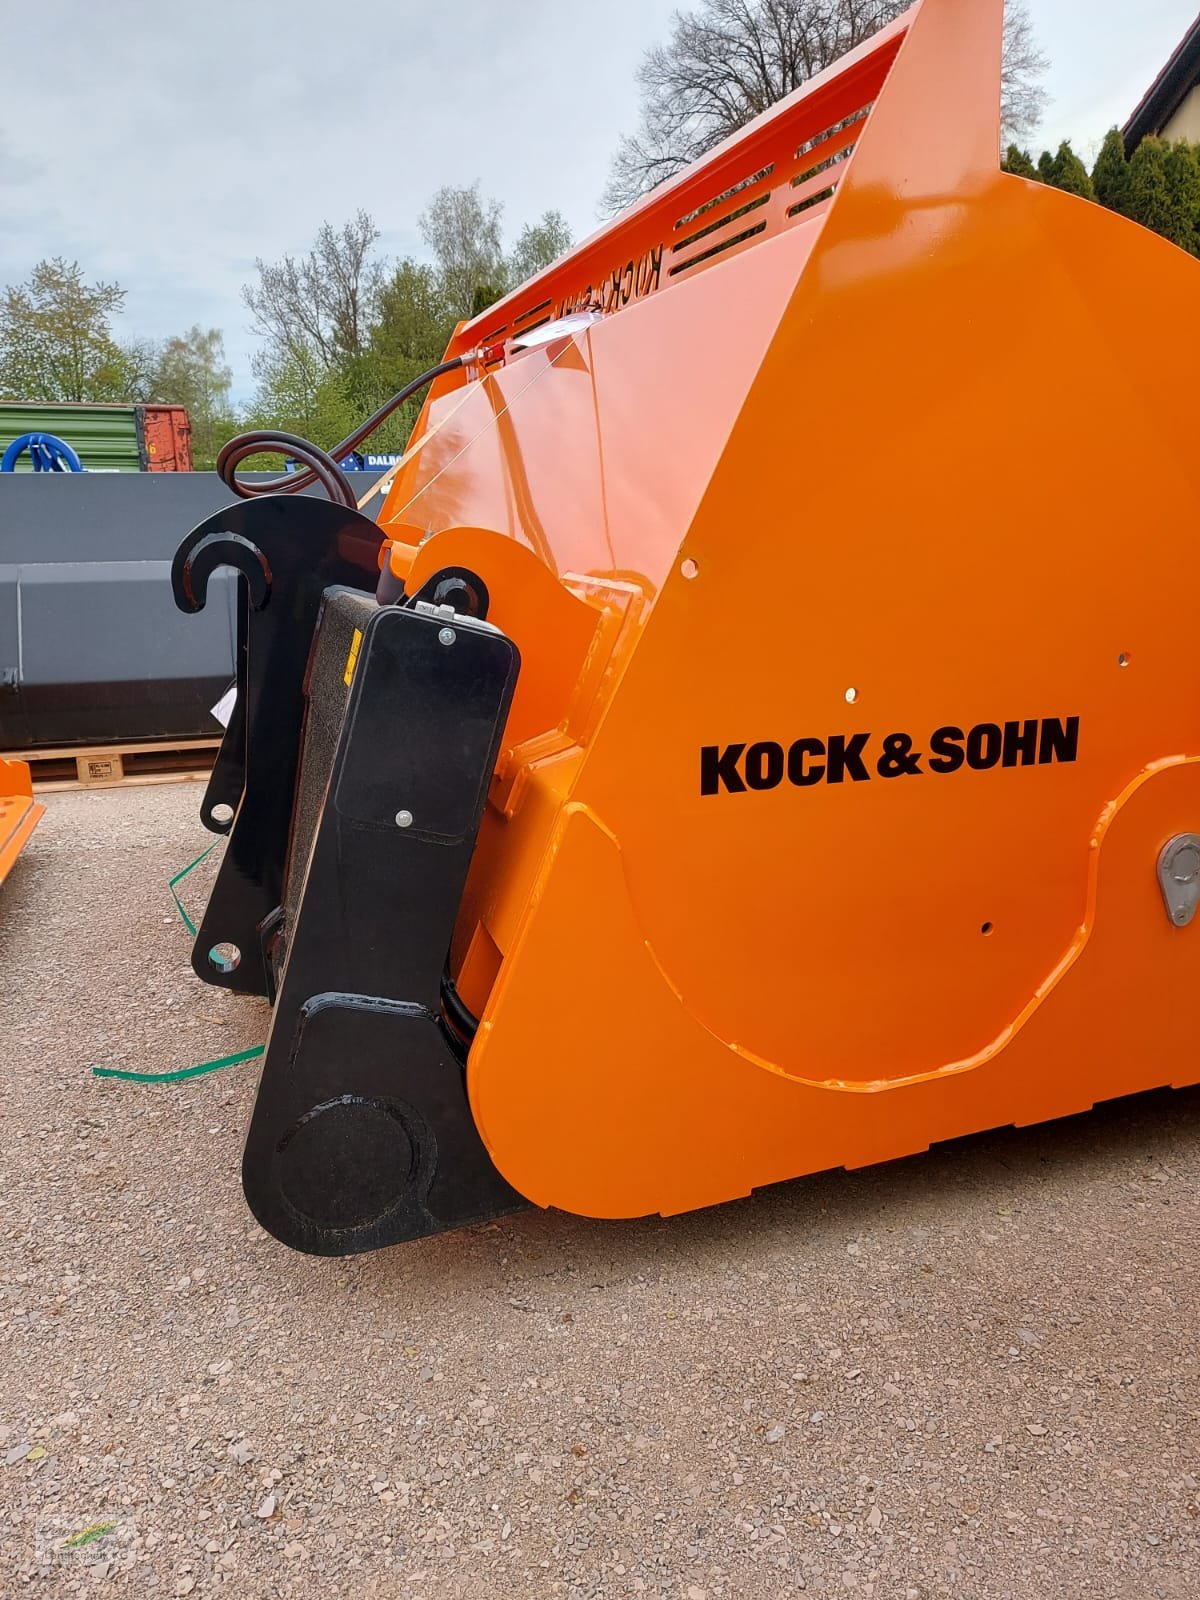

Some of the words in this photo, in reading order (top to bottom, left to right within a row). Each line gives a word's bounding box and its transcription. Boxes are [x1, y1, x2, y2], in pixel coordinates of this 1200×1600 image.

[700, 732, 872, 796] KOCK
[876, 732, 923, 779] &
[928, 715, 1080, 774] SOHN
